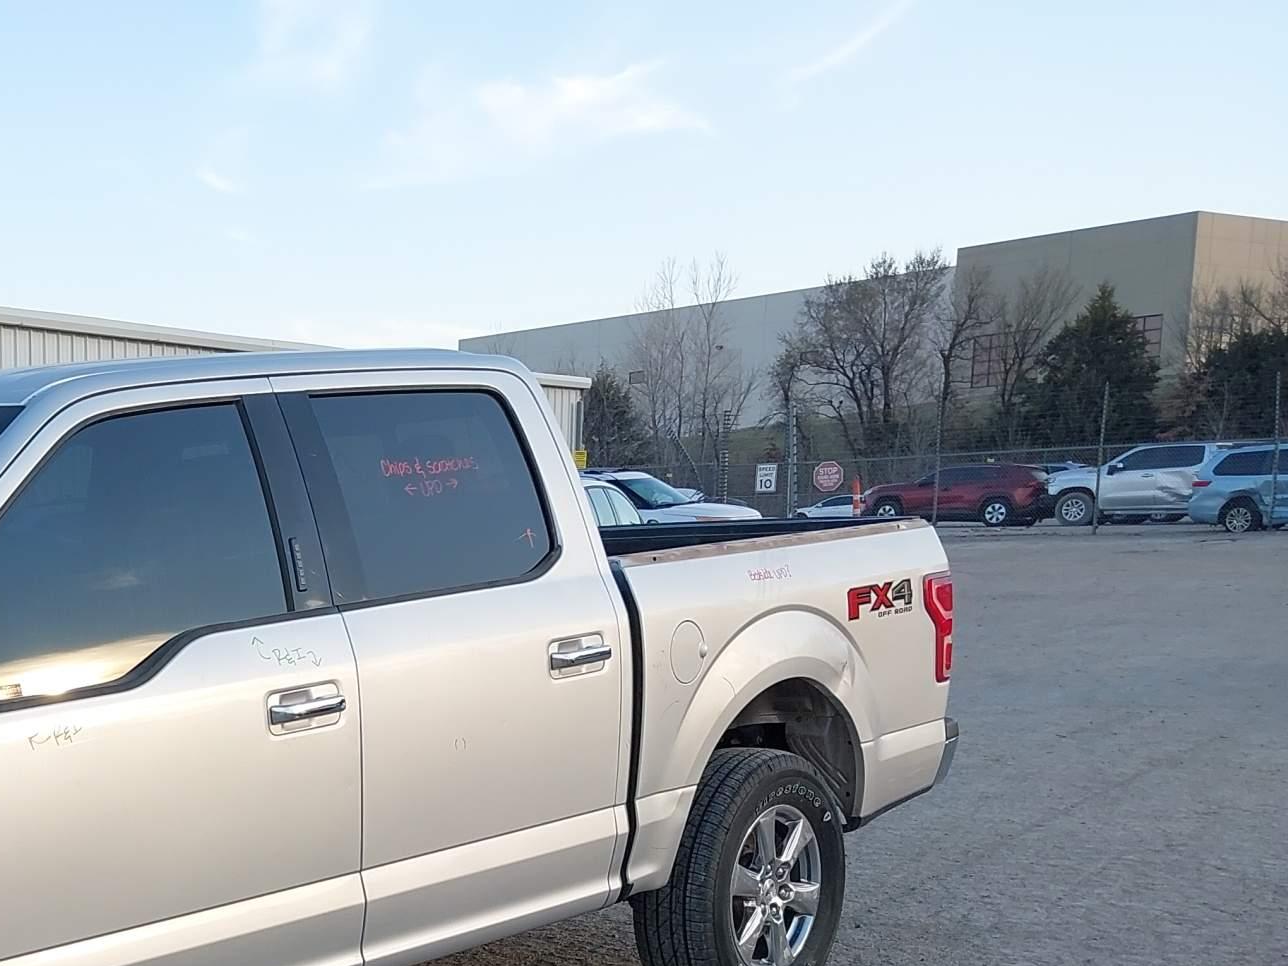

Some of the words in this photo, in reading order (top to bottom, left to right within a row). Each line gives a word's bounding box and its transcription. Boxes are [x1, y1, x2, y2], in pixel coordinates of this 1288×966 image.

[818, 467, 839, 475] STOP
[759, 478, 773, 489] 10
[847, 578, 913, 622] FX4
[877, 610, 892, 618] OFF
[894, 606, 913, 615] ROAD
